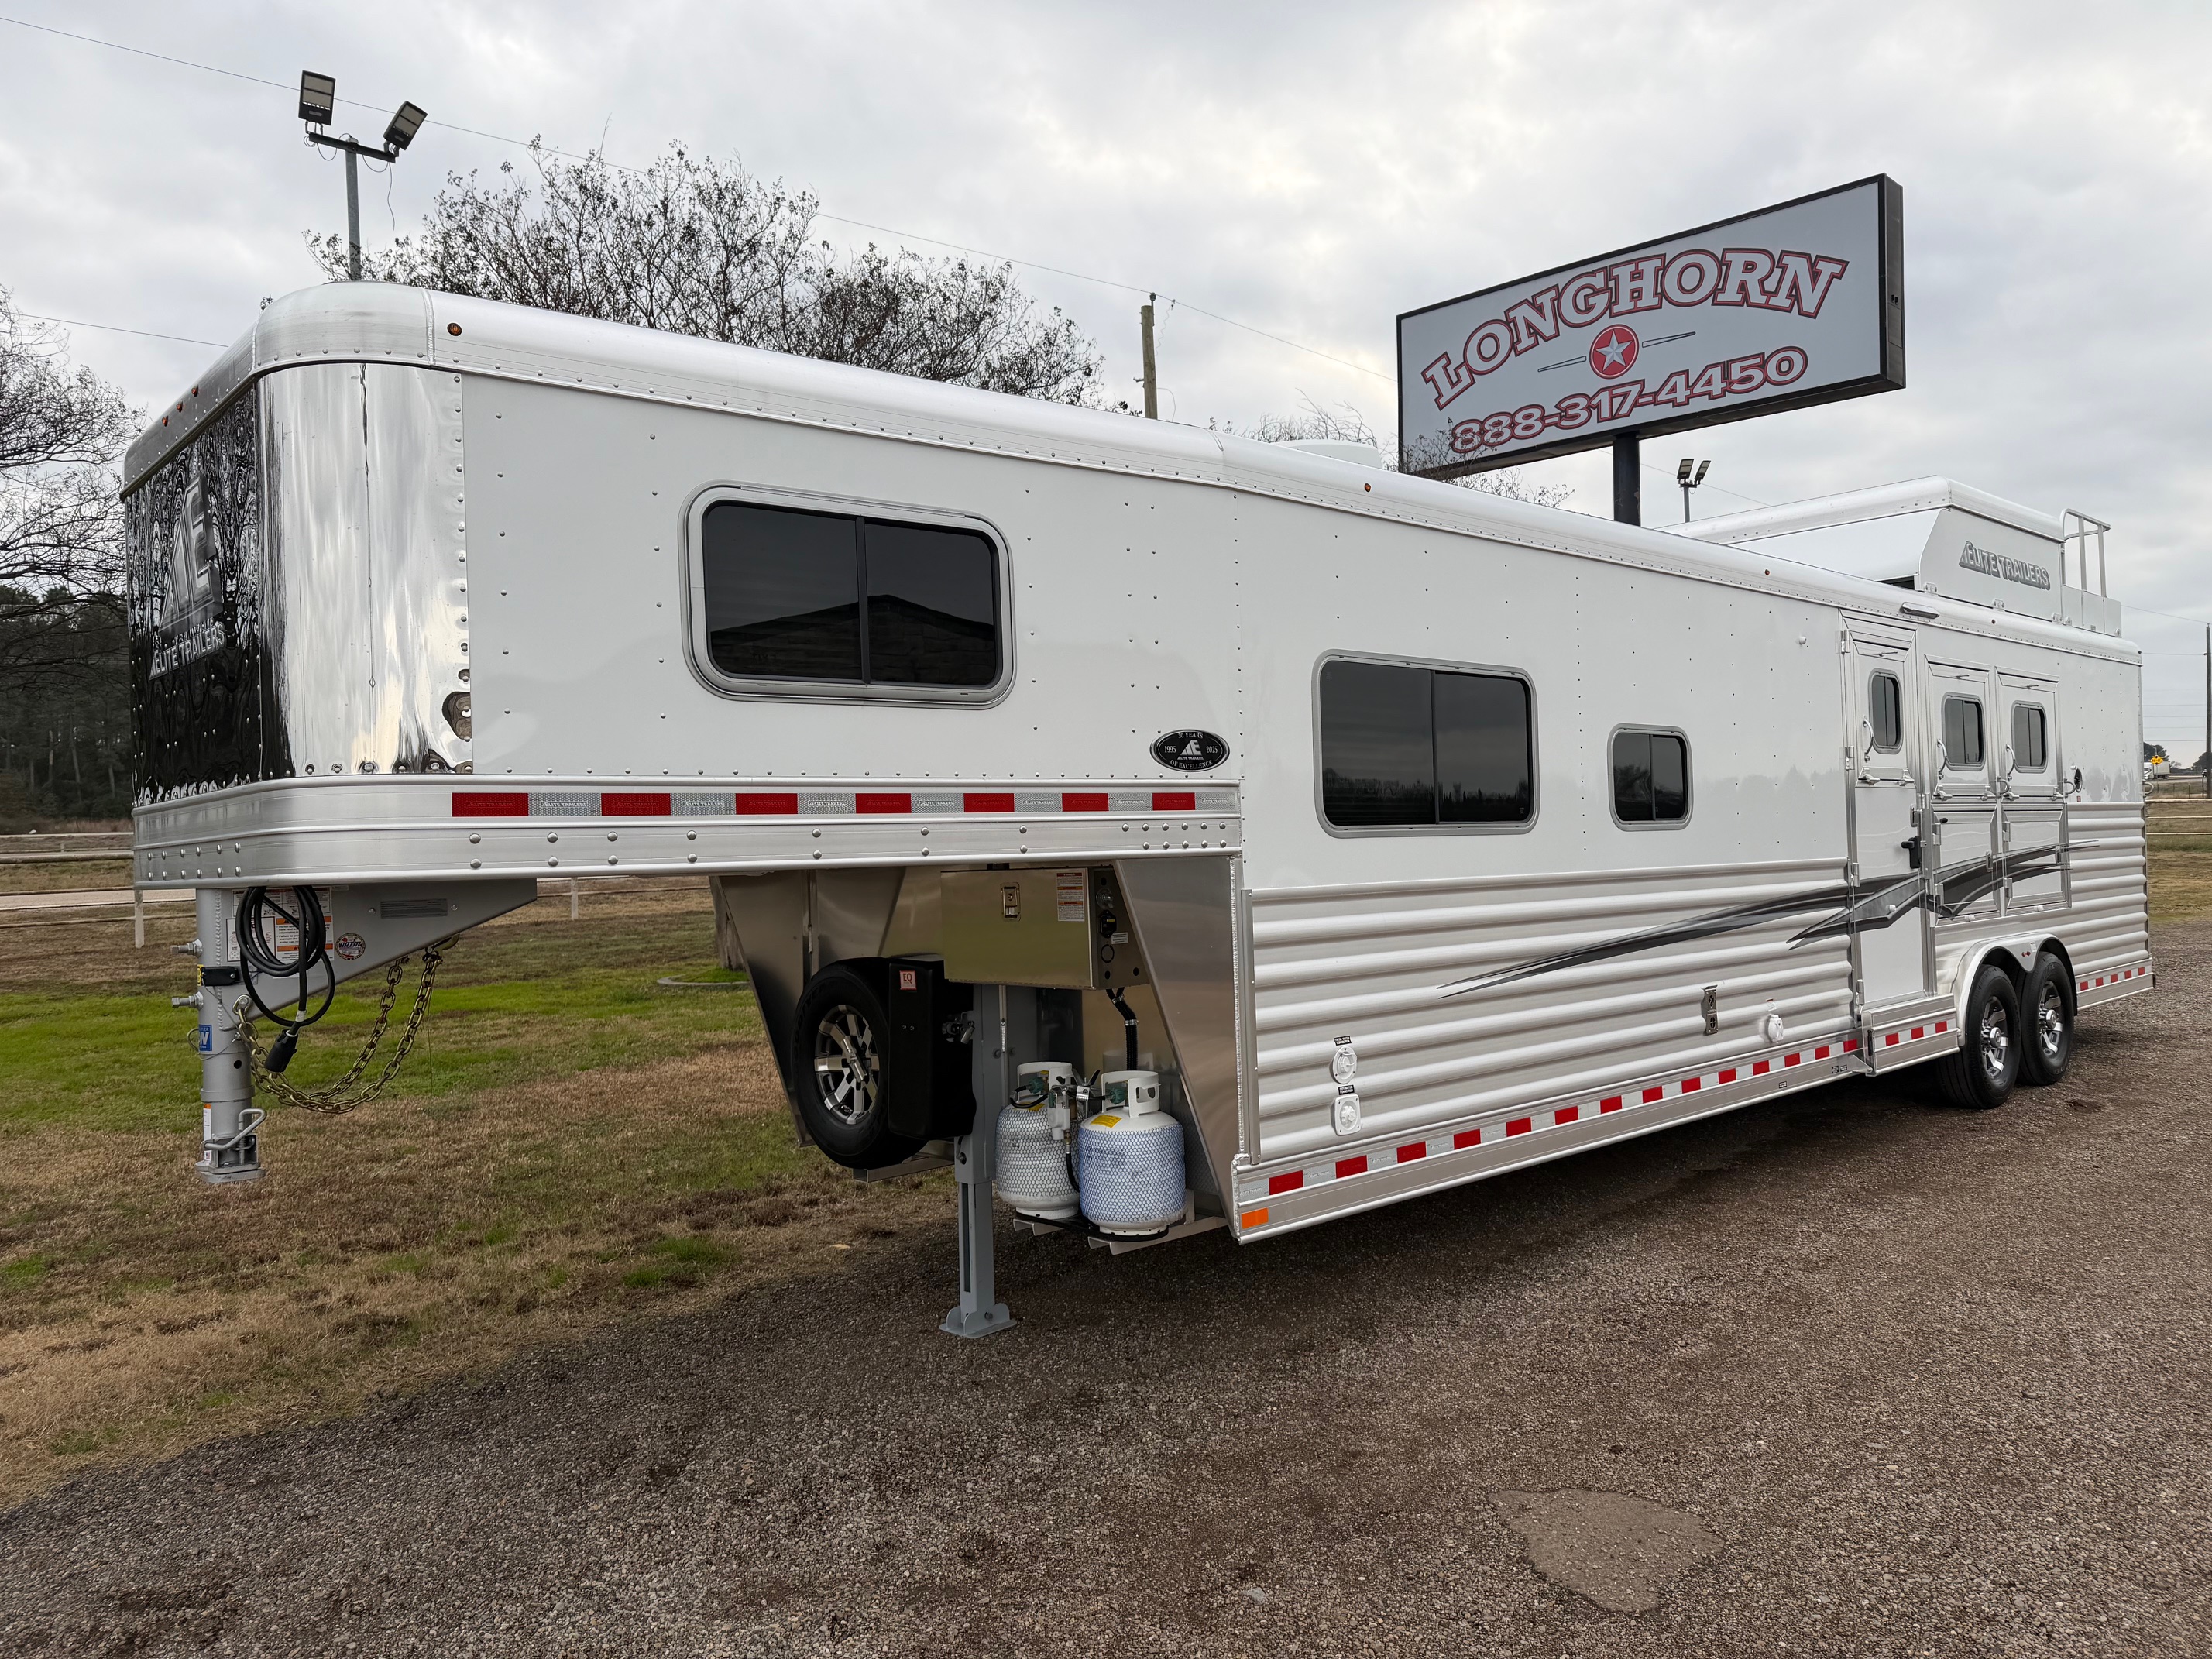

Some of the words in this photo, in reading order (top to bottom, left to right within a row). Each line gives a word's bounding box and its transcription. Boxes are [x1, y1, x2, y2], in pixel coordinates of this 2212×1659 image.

[1422, 247, 1850, 410] LONGHORN
[1451, 345, 1808, 454] 888-317-4450
[1959, 541, 2001, 579] ELITE
[1997, 555, 2051, 591] TRAILERS
[149, 647, 180, 681] ELITE
[178, 621, 227, 667] TRAILERS
[1179, 760, 1213, 770] EXCELLENCE
[903, 973, 912, 984] EQ
